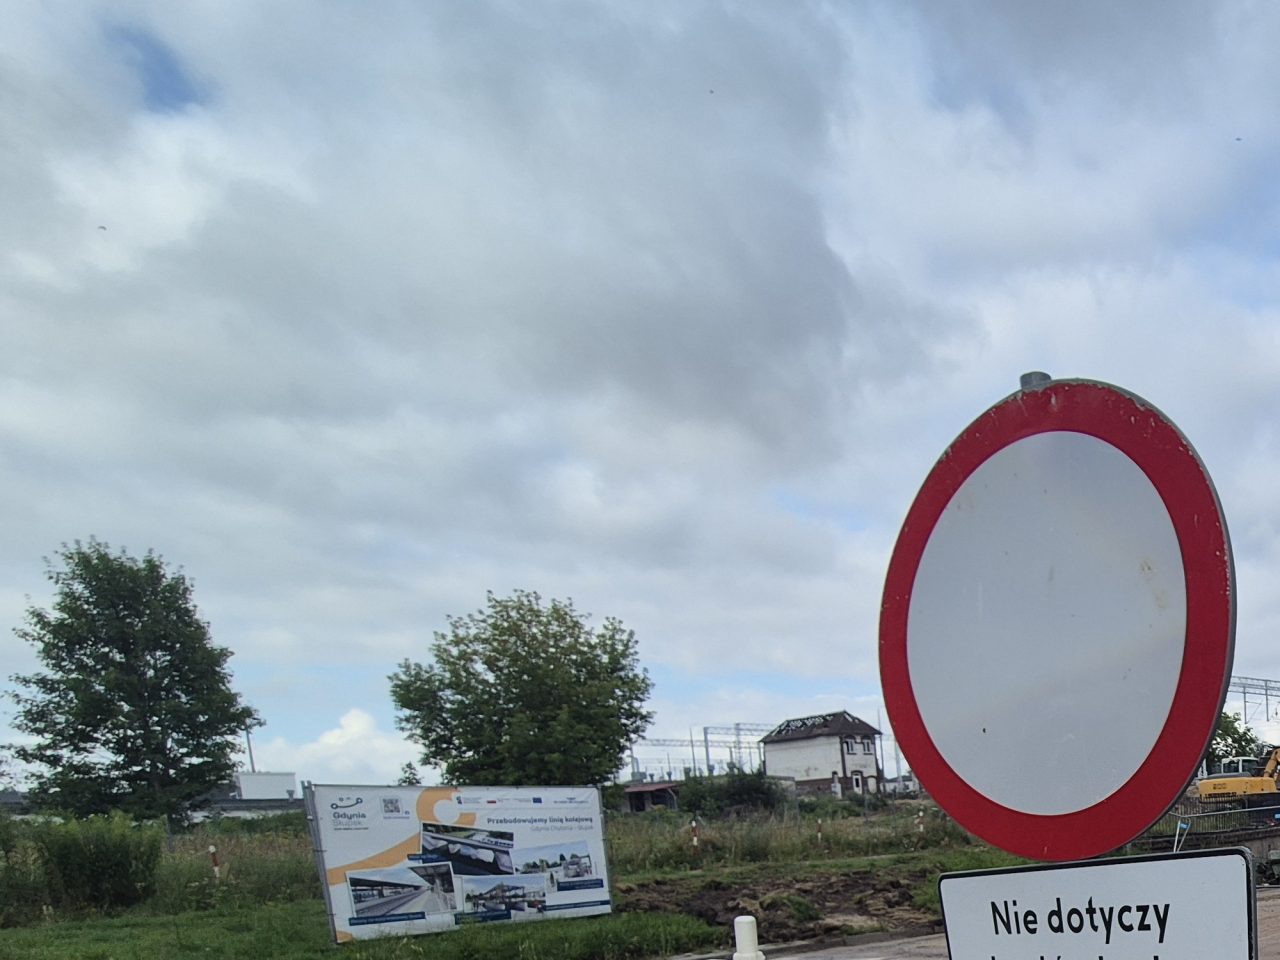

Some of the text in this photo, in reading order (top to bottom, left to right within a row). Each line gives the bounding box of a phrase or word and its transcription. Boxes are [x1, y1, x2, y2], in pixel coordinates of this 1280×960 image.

[332, 811, 367, 820] Gdynia
[487, 816, 548, 825] Przebudowujemy
[990, 896, 1170, 945] Nie dotyczy
